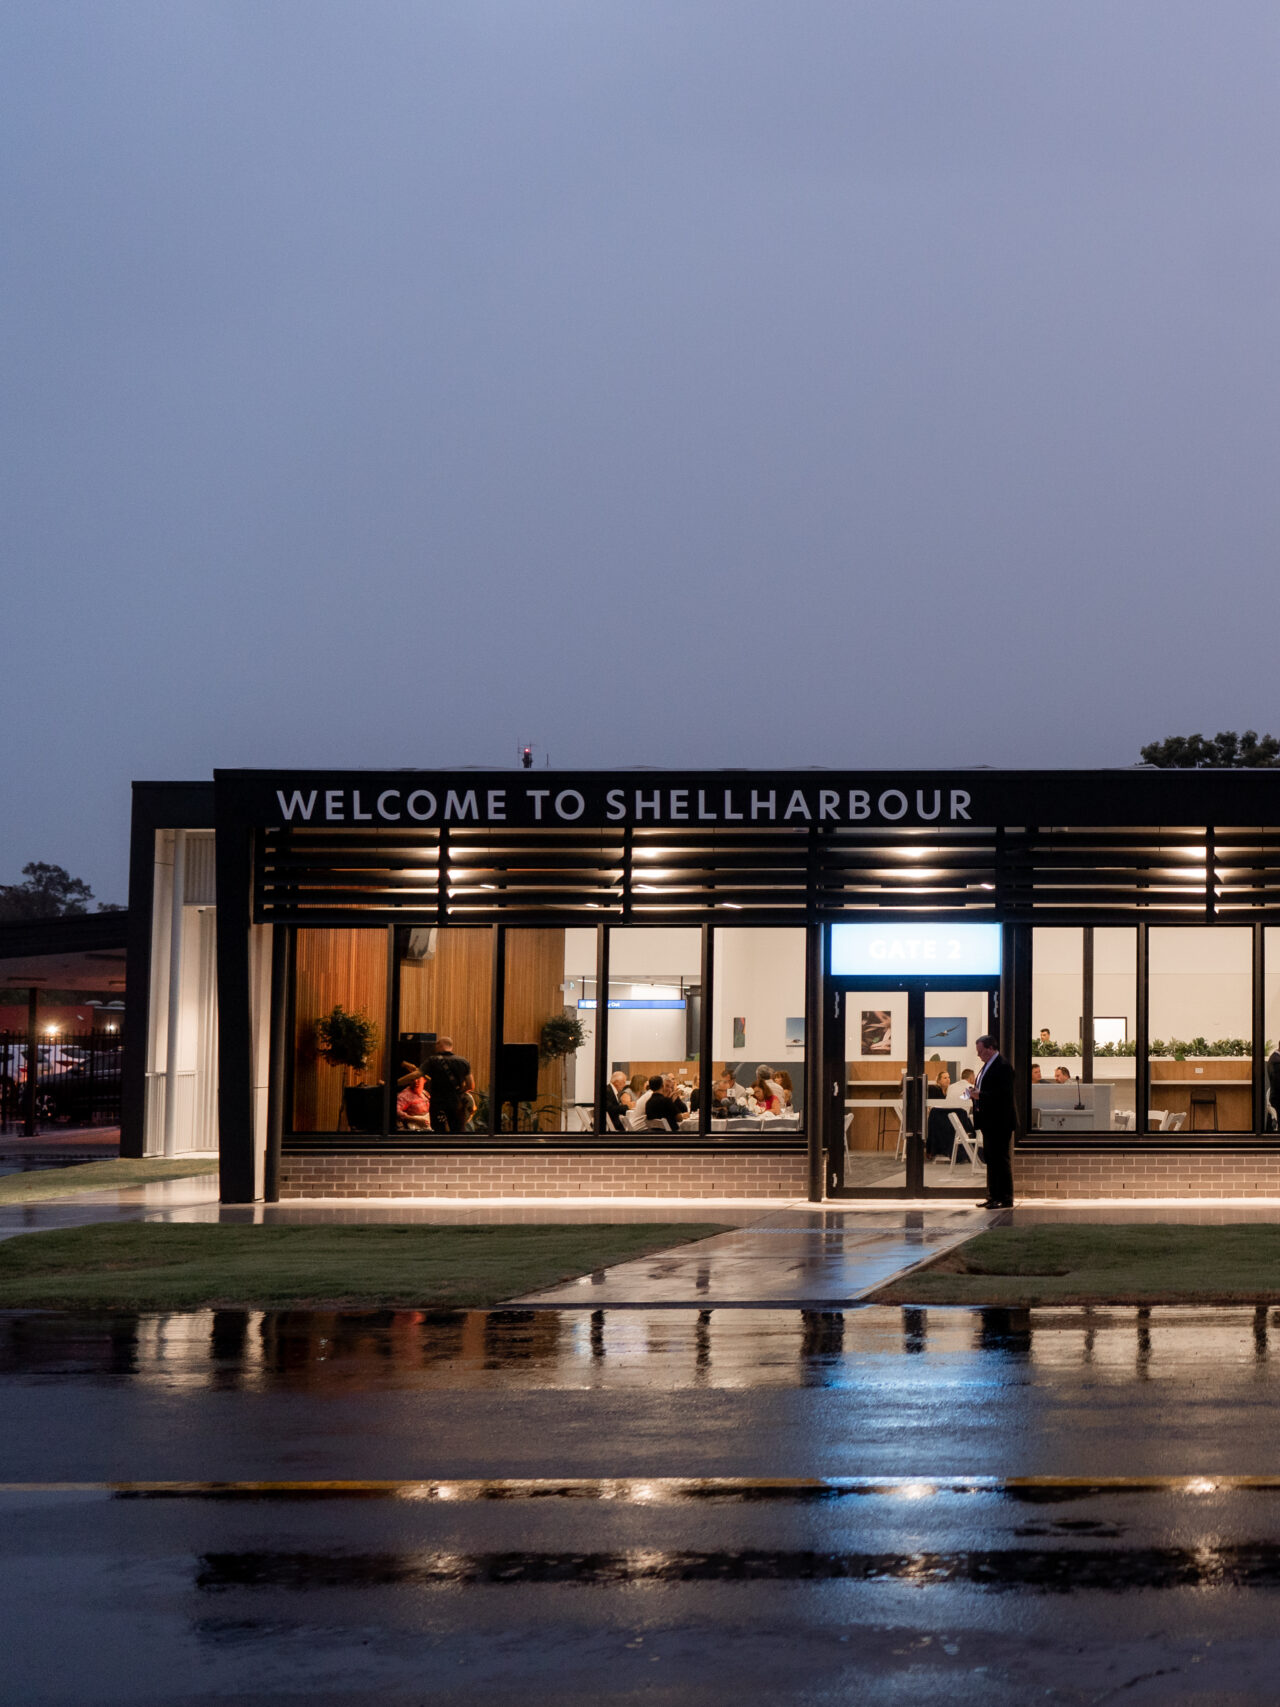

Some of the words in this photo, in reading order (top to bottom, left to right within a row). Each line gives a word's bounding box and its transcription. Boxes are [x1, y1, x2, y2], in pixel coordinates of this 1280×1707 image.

[276, 789, 506, 821] WELCOME
[526, 789, 585, 821] TO
[605, 789, 972, 821] SHELLHARBOUR
[869, 938, 937, 960] GATE
[947, 938, 961, 960] 2
